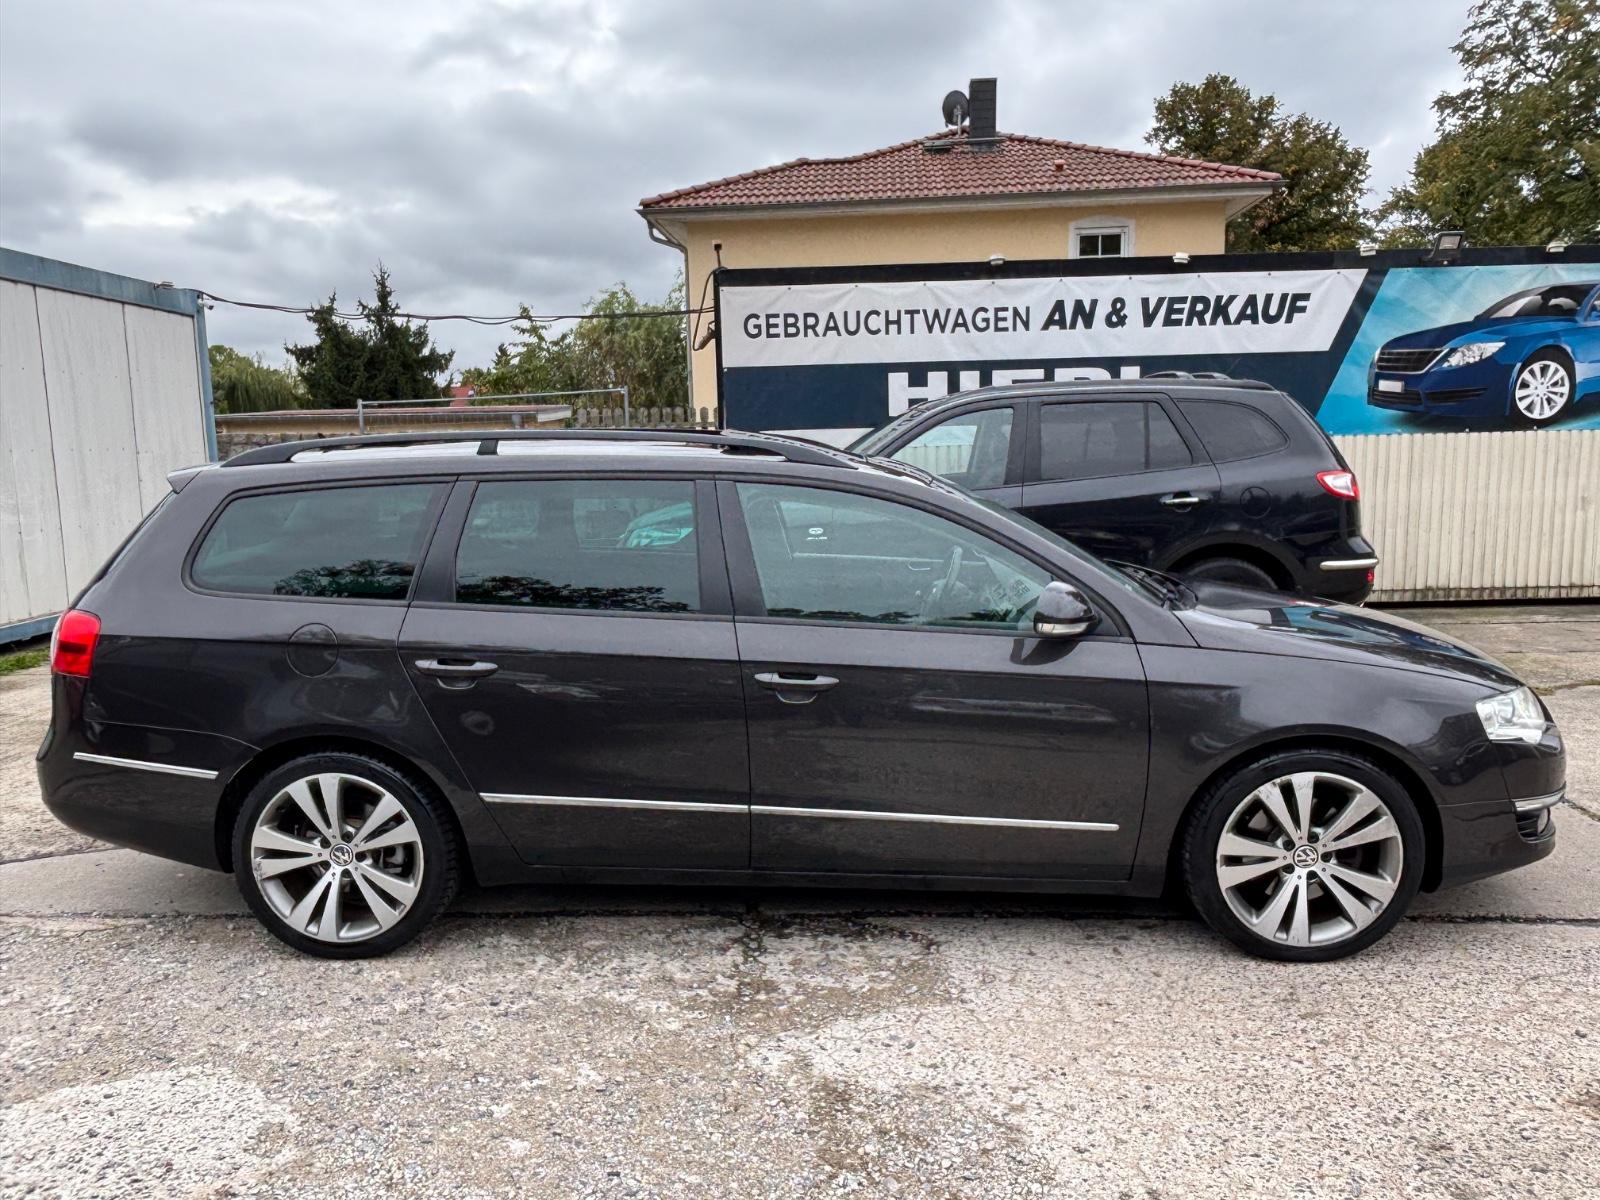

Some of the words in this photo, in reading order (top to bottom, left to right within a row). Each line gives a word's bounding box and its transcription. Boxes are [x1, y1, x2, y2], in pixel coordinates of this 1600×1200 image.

[743, 306, 1031, 339] GEBRAUCHTWAGEN
[1040, 298, 1098, 331] AN
[1104, 297, 1128, 328] &
[1140, 292, 1311, 328] VERKAUF
